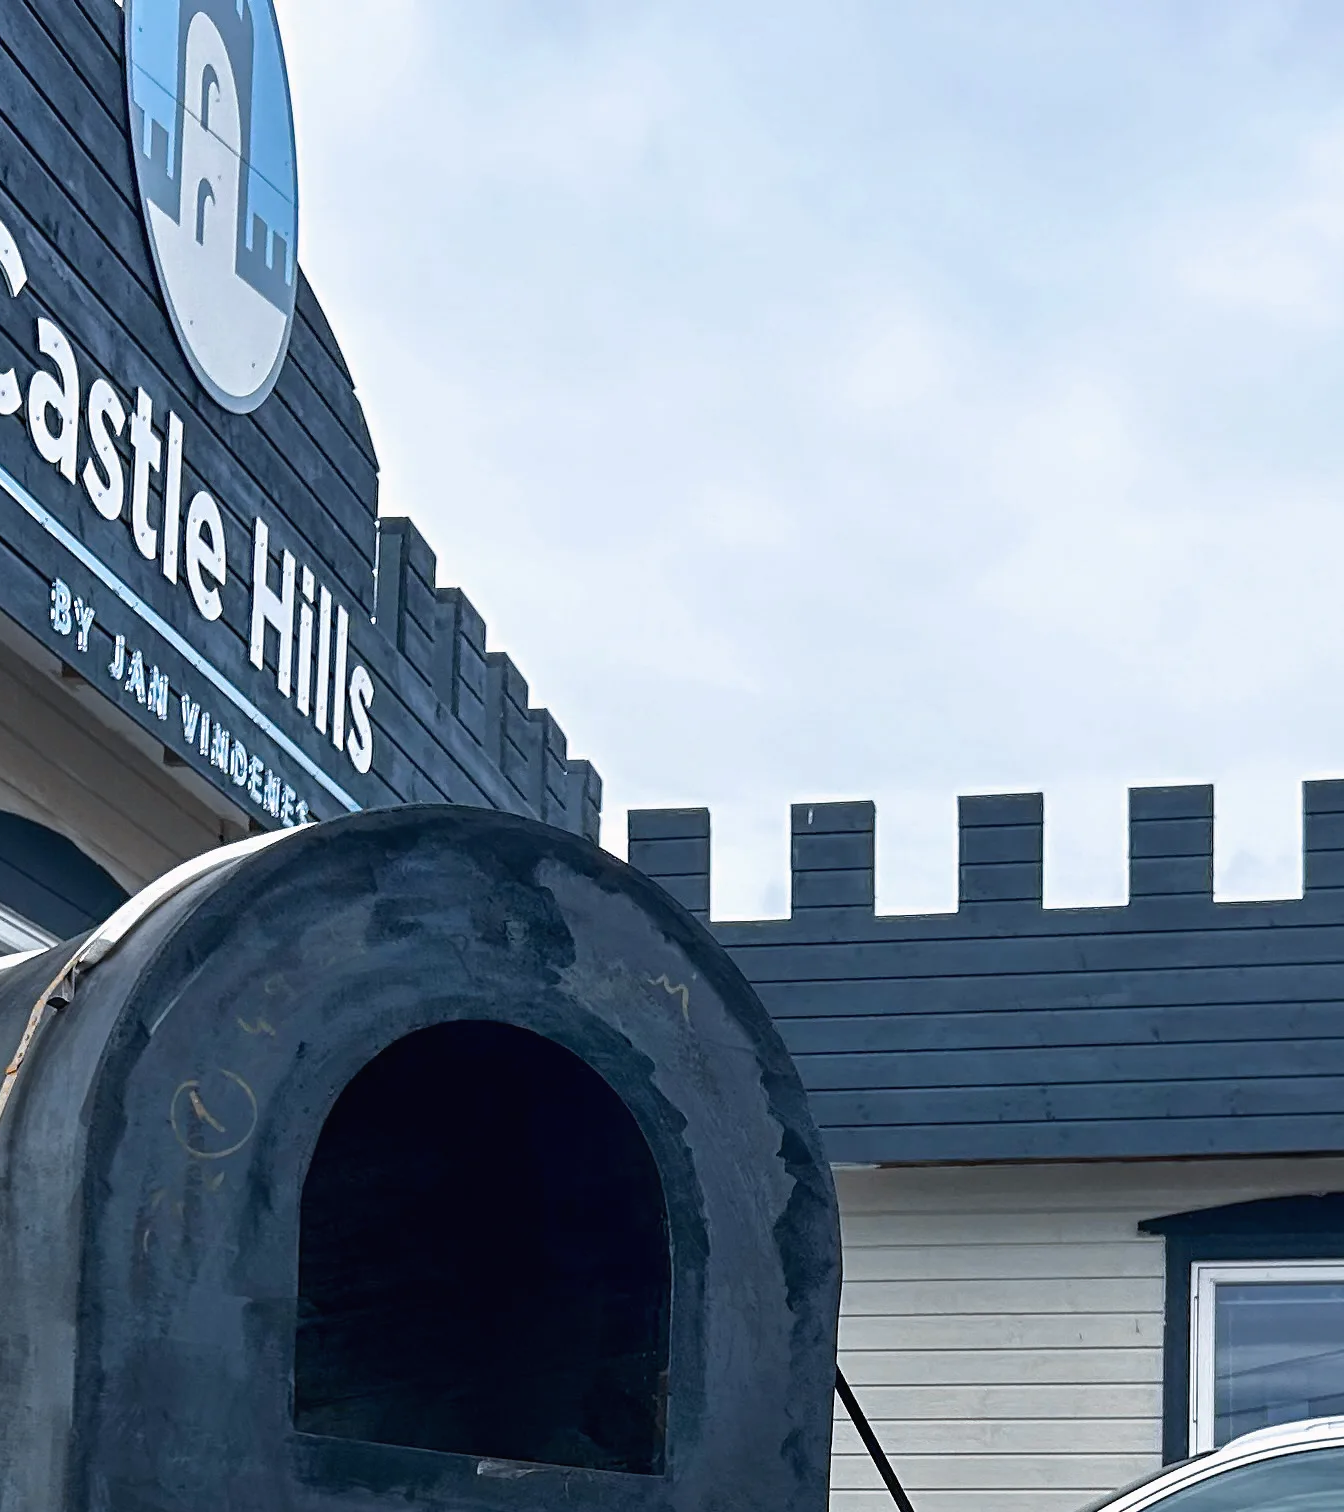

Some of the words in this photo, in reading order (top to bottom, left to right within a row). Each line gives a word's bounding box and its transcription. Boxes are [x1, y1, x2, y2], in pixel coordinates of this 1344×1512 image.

[50, 577, 95, 652] BY
[107, 634, 169, 721] JAN
[249, 516, 376, 774] Hills
